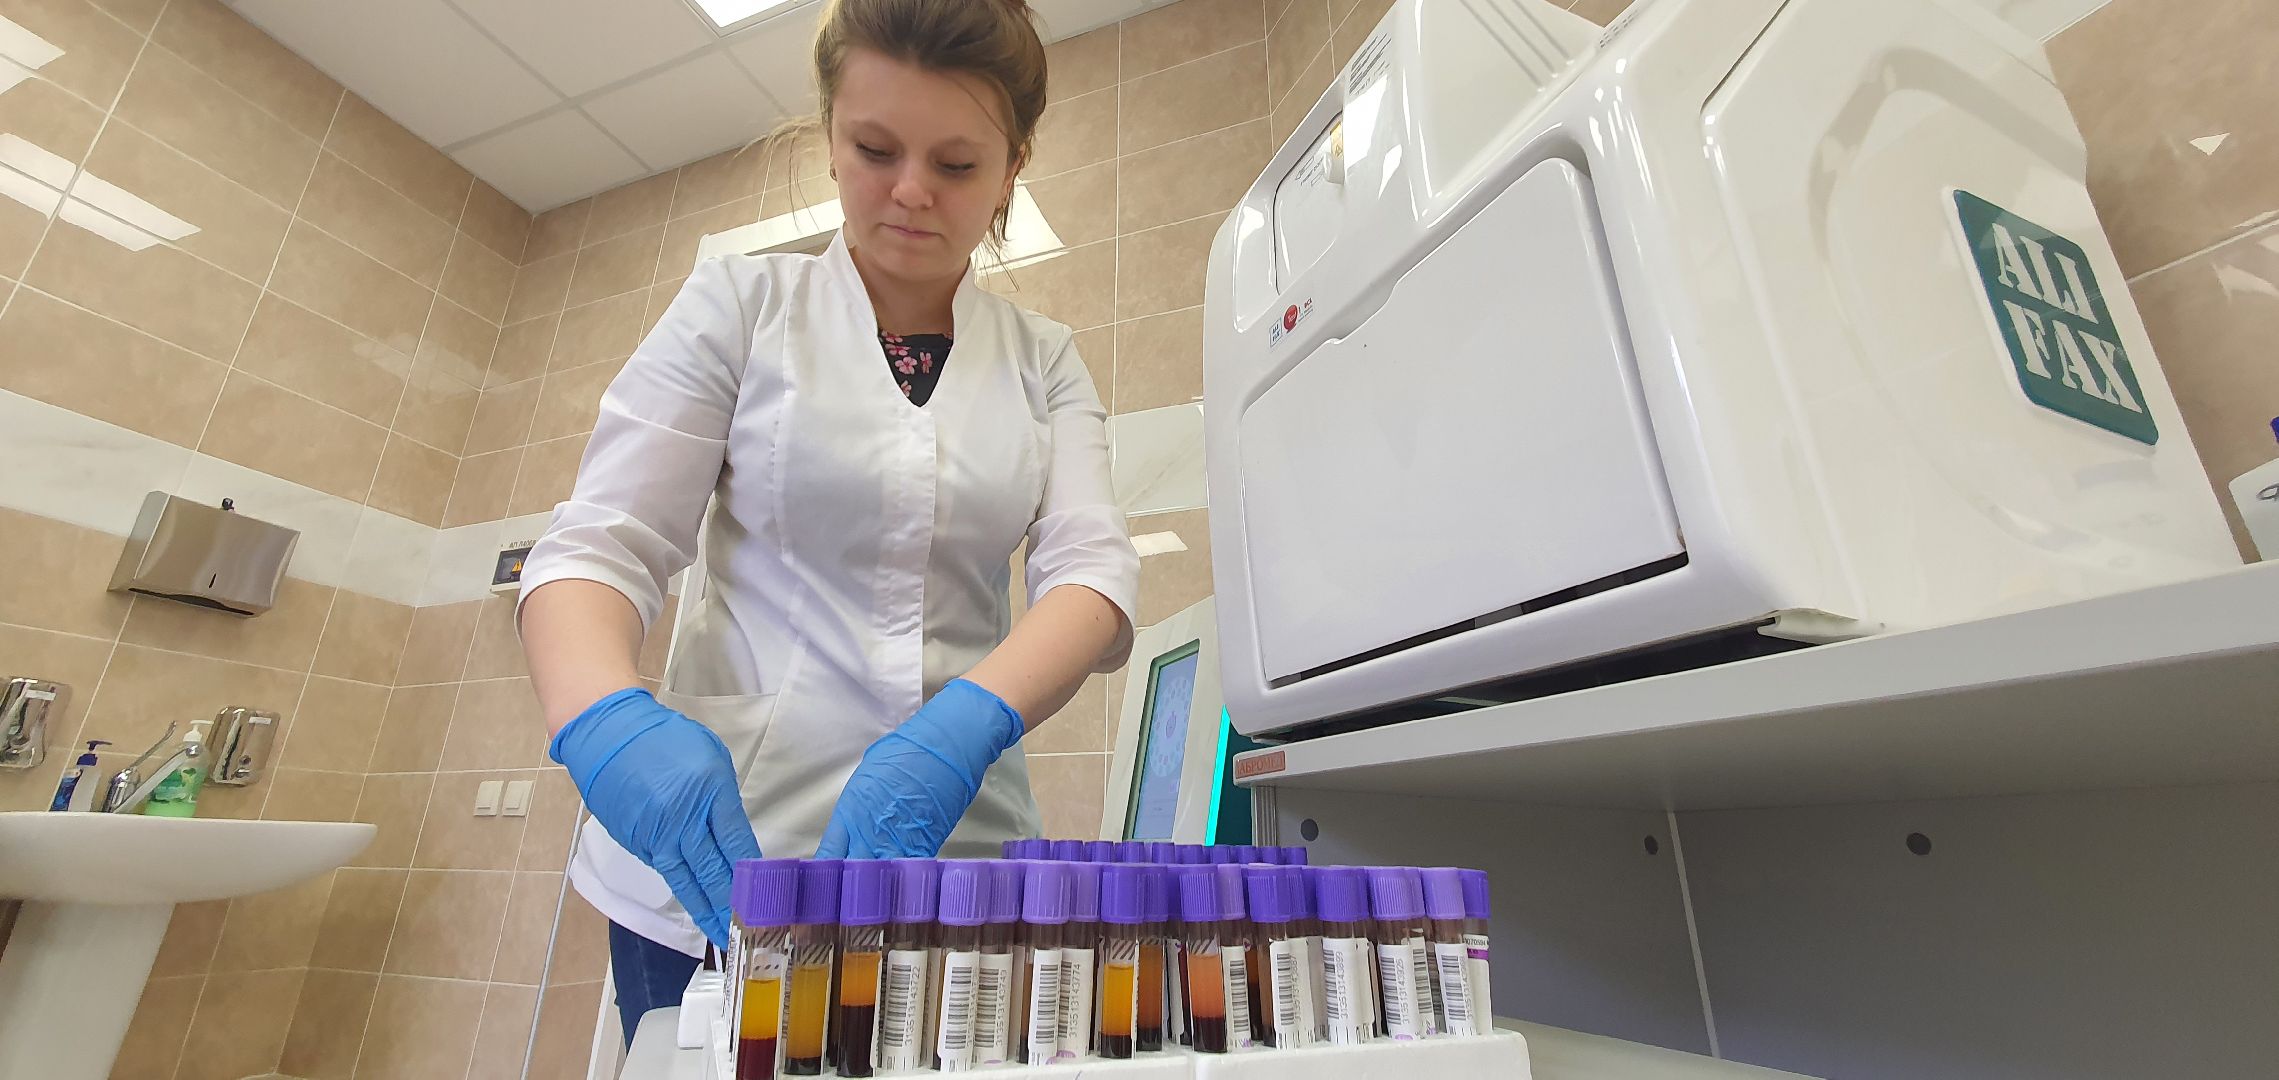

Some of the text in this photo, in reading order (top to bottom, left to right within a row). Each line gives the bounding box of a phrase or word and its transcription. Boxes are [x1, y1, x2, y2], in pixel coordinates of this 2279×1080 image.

[1992, 222, 2099, 324] ALI
[2003, 300, 2144, 414] FAX
[904, 965, 920, 1045] 313513143722
[1069, 964, 1080, 1038] 313513143774
